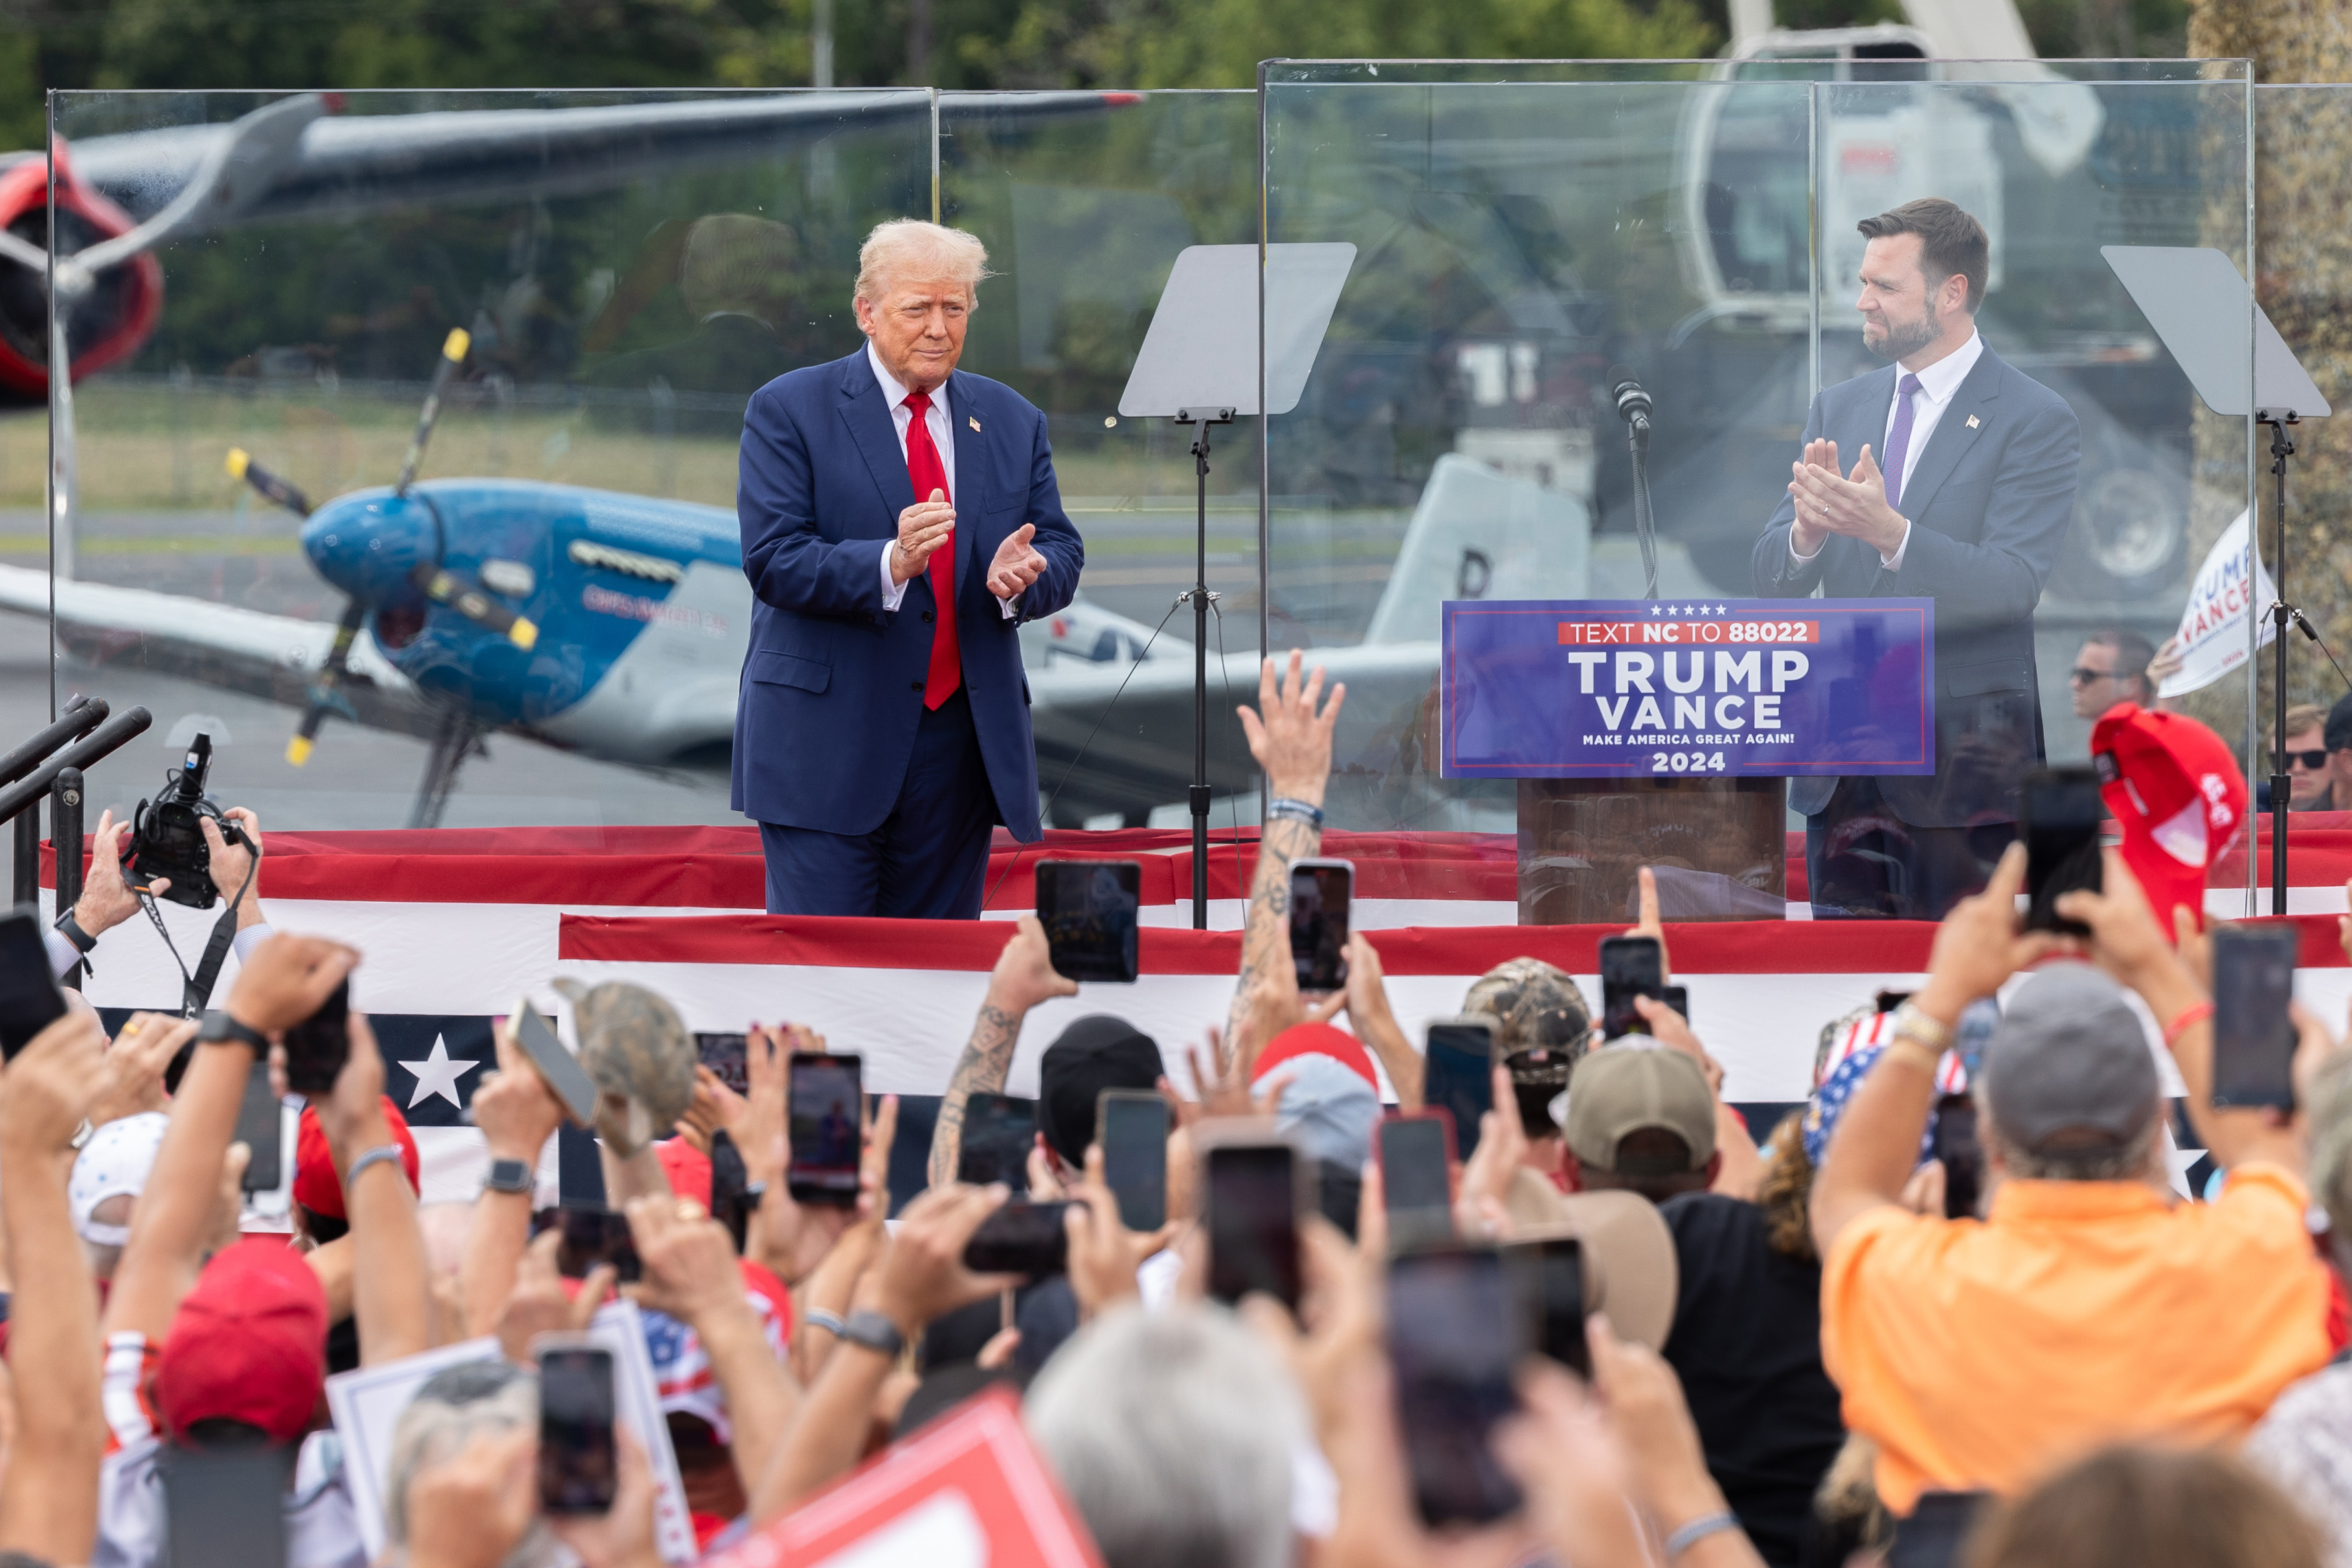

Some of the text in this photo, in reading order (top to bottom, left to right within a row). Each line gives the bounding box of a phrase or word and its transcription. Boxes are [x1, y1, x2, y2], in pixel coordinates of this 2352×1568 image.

[1570, 622, 1808, 643] TEXT NC TO 88022
[1568, 650, 1809, 694] TRUMP
[1595, 695, 1781, 730] VANCE
[1583, 734, 1795, 745] MAKE AMERICA GREAT AGAIN!
[1652, 752, 1725, 772] 2024
[140, 894, 167, 935] SONY
